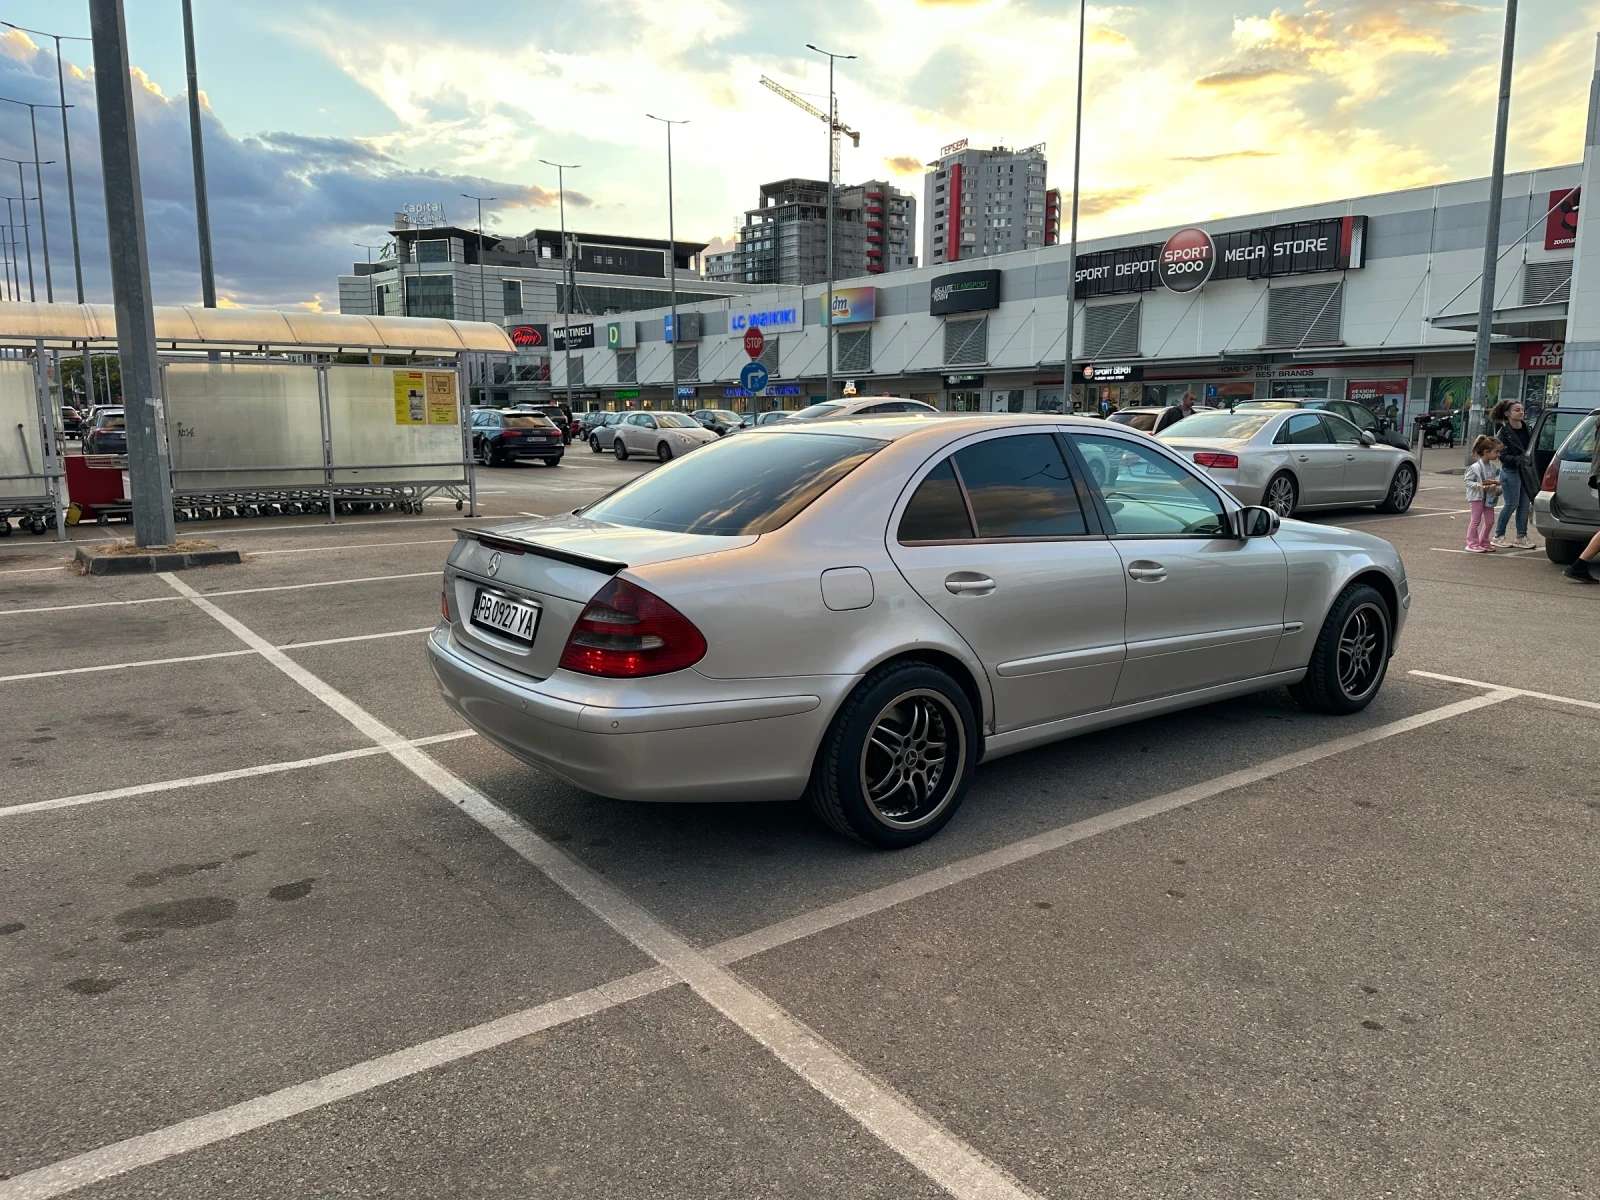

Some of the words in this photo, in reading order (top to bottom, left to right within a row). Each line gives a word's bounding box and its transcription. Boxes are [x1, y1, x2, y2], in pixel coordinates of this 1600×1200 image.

[940, 138, 968, 156] ГЕРБЕРА
[403, 201, 442, 214] Capital
[1075, 266, 1110, 282] SPORT
[1115, 260, 1157, 276] DEPOT
[1224, 245, 1265, 262] MEGA
[1273, 237, 1328, 256] STORE
[1165, 246, 1209, 262] SPORT
[1167, 260, 1204, 275] 2000
[953, 281, 990, 290] TEAMSPORT
[832, 296, 848, 310] dm
[732, 315, 746, 330] LC
[515, 331, 537, 345] Happy
[609, 326, 618, 344] D
[746, 337, 762, 348] STOP
[1541, 342, 1565, 356] zo
[1530, 354, 1563, 366] mar
[1278, 369, 1314, 377] BRANDS
[478, 595, 492, 620] PB
[491, 600, 518, 628] 0927
[517, 608, 533, 636] YA
